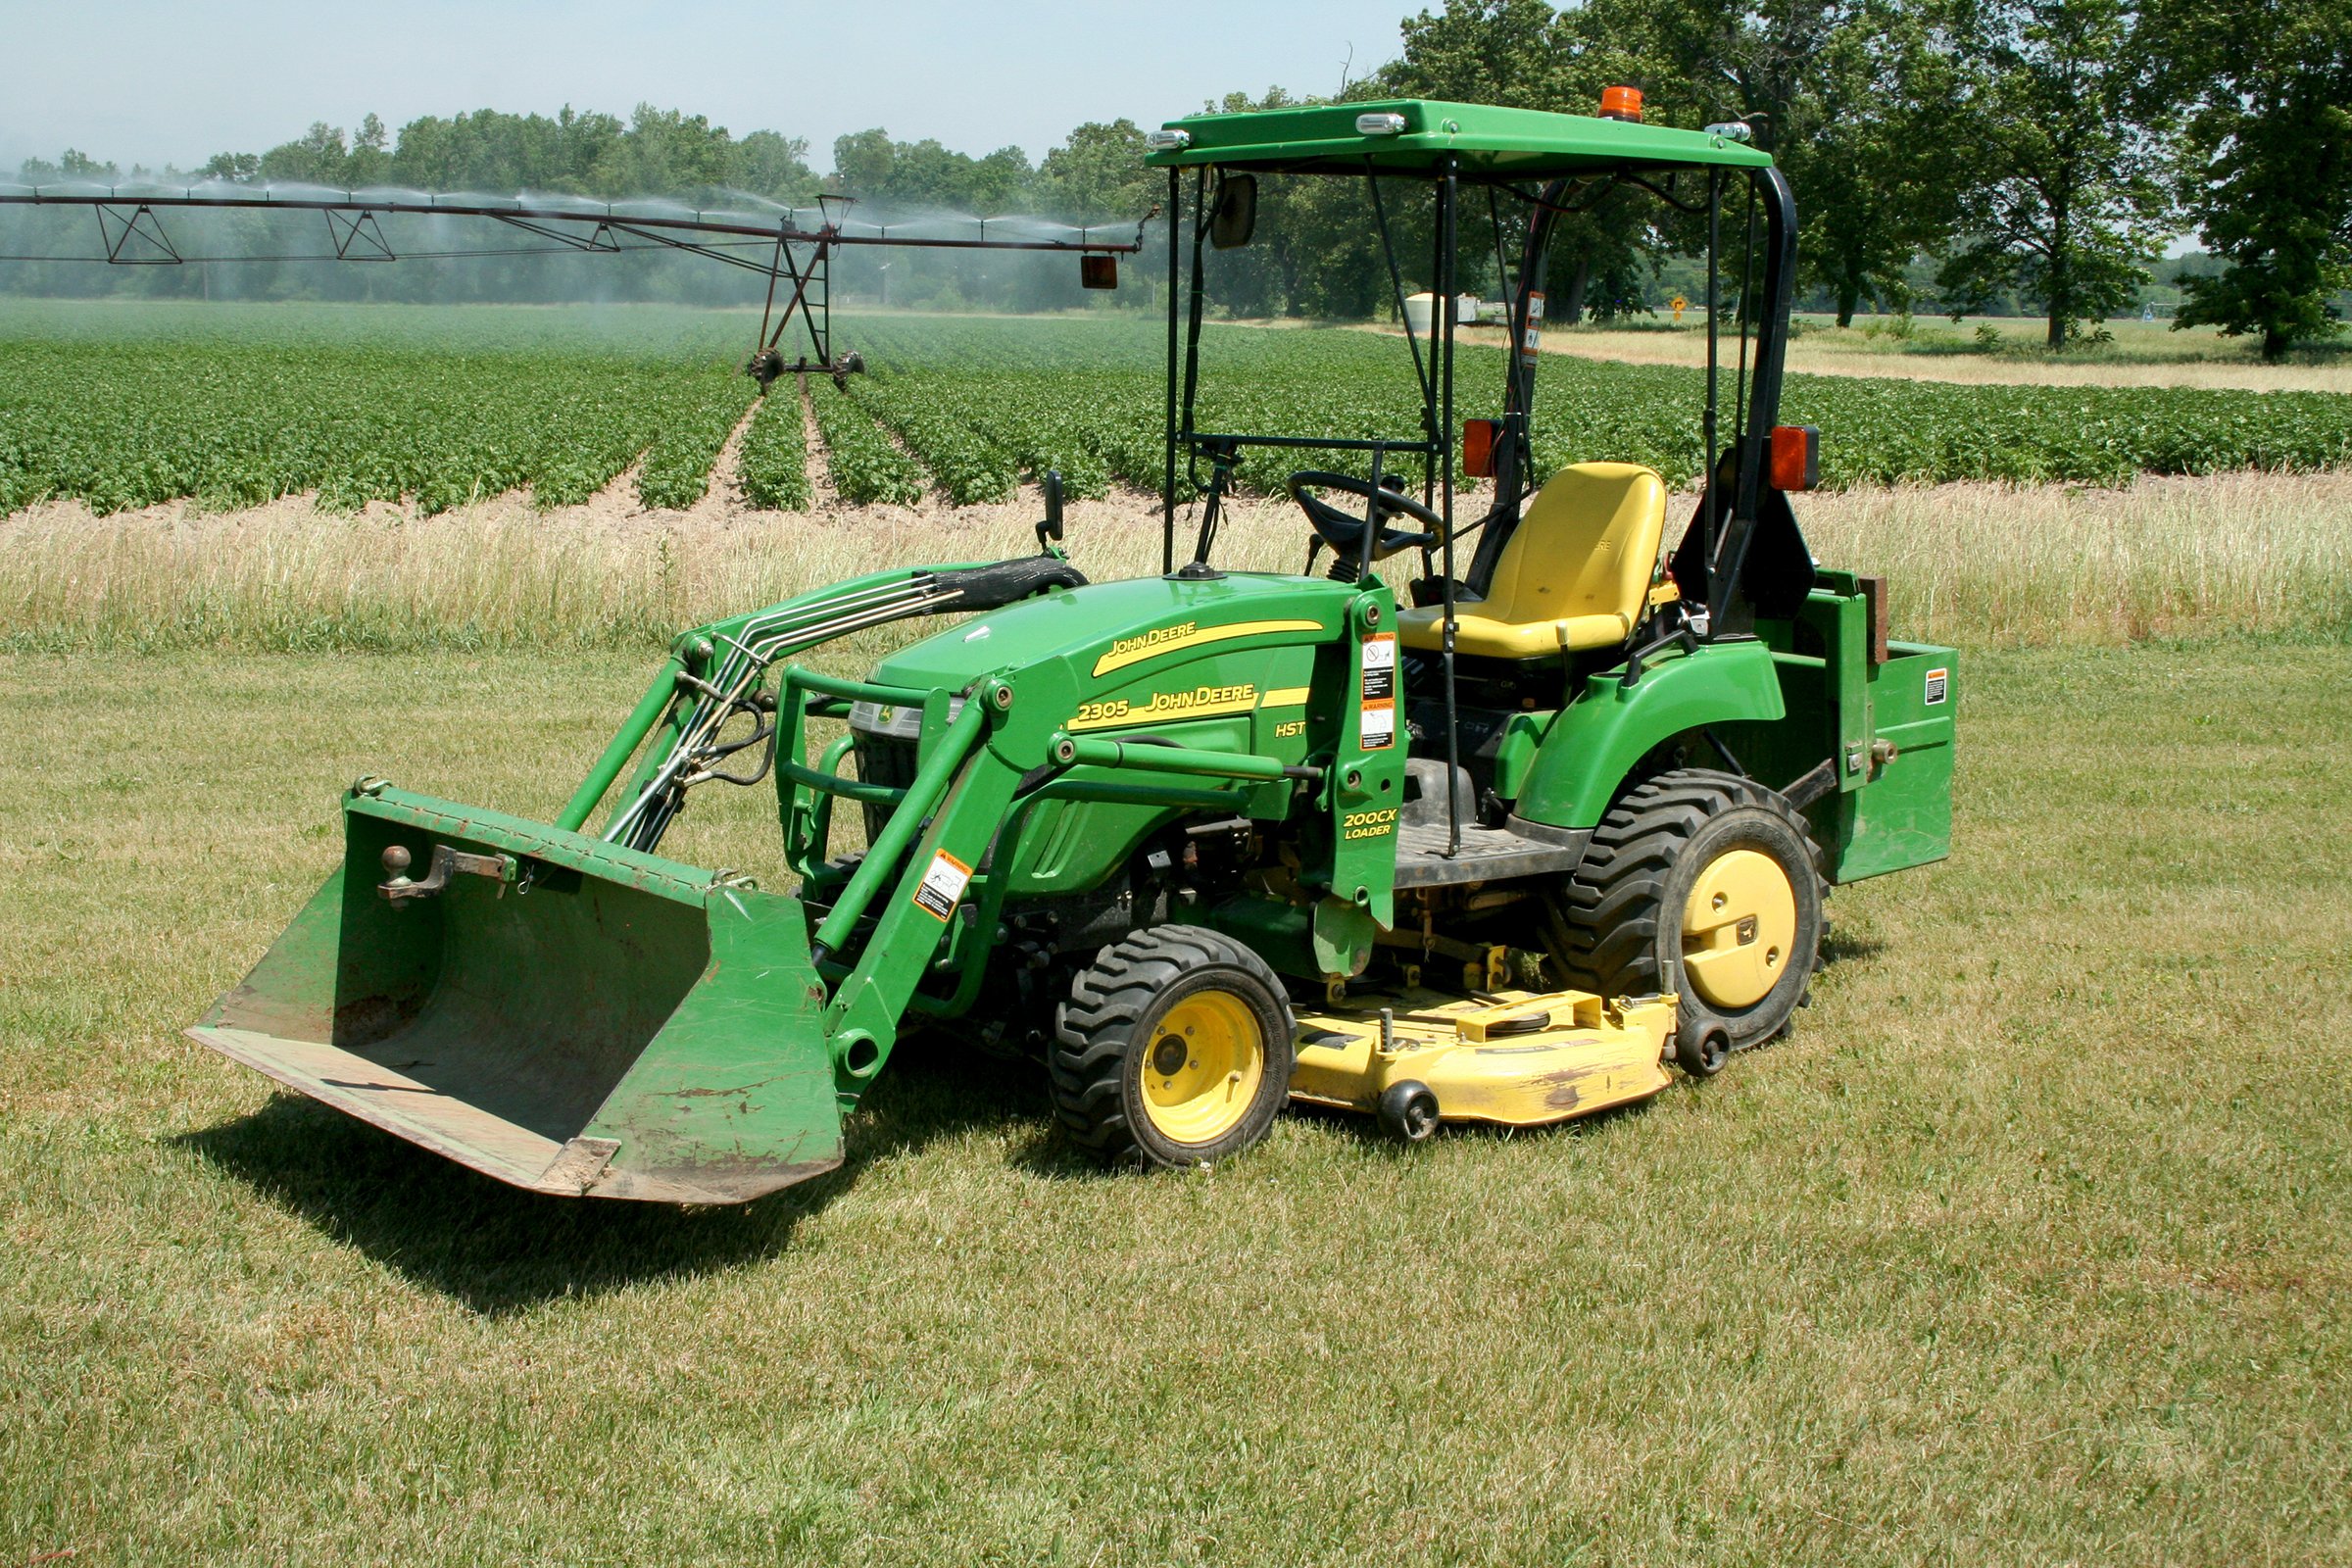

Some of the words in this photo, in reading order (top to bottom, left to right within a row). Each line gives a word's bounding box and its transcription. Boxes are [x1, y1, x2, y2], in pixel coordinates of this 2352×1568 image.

[1107, 635, 1147, 657] JOHN
[1148, 621, 1196, 646] DEERE
[1078, 699, 1128, 721] 2305
[1145, 691, 1194, 712] JOHN
[1195, 684, 1254, 706] DEERE
[1275, 721, 1306, 738] HST
[1343, 808, 1397, 827] 200CX
[1345, 824, 1391, 840] LOADER
